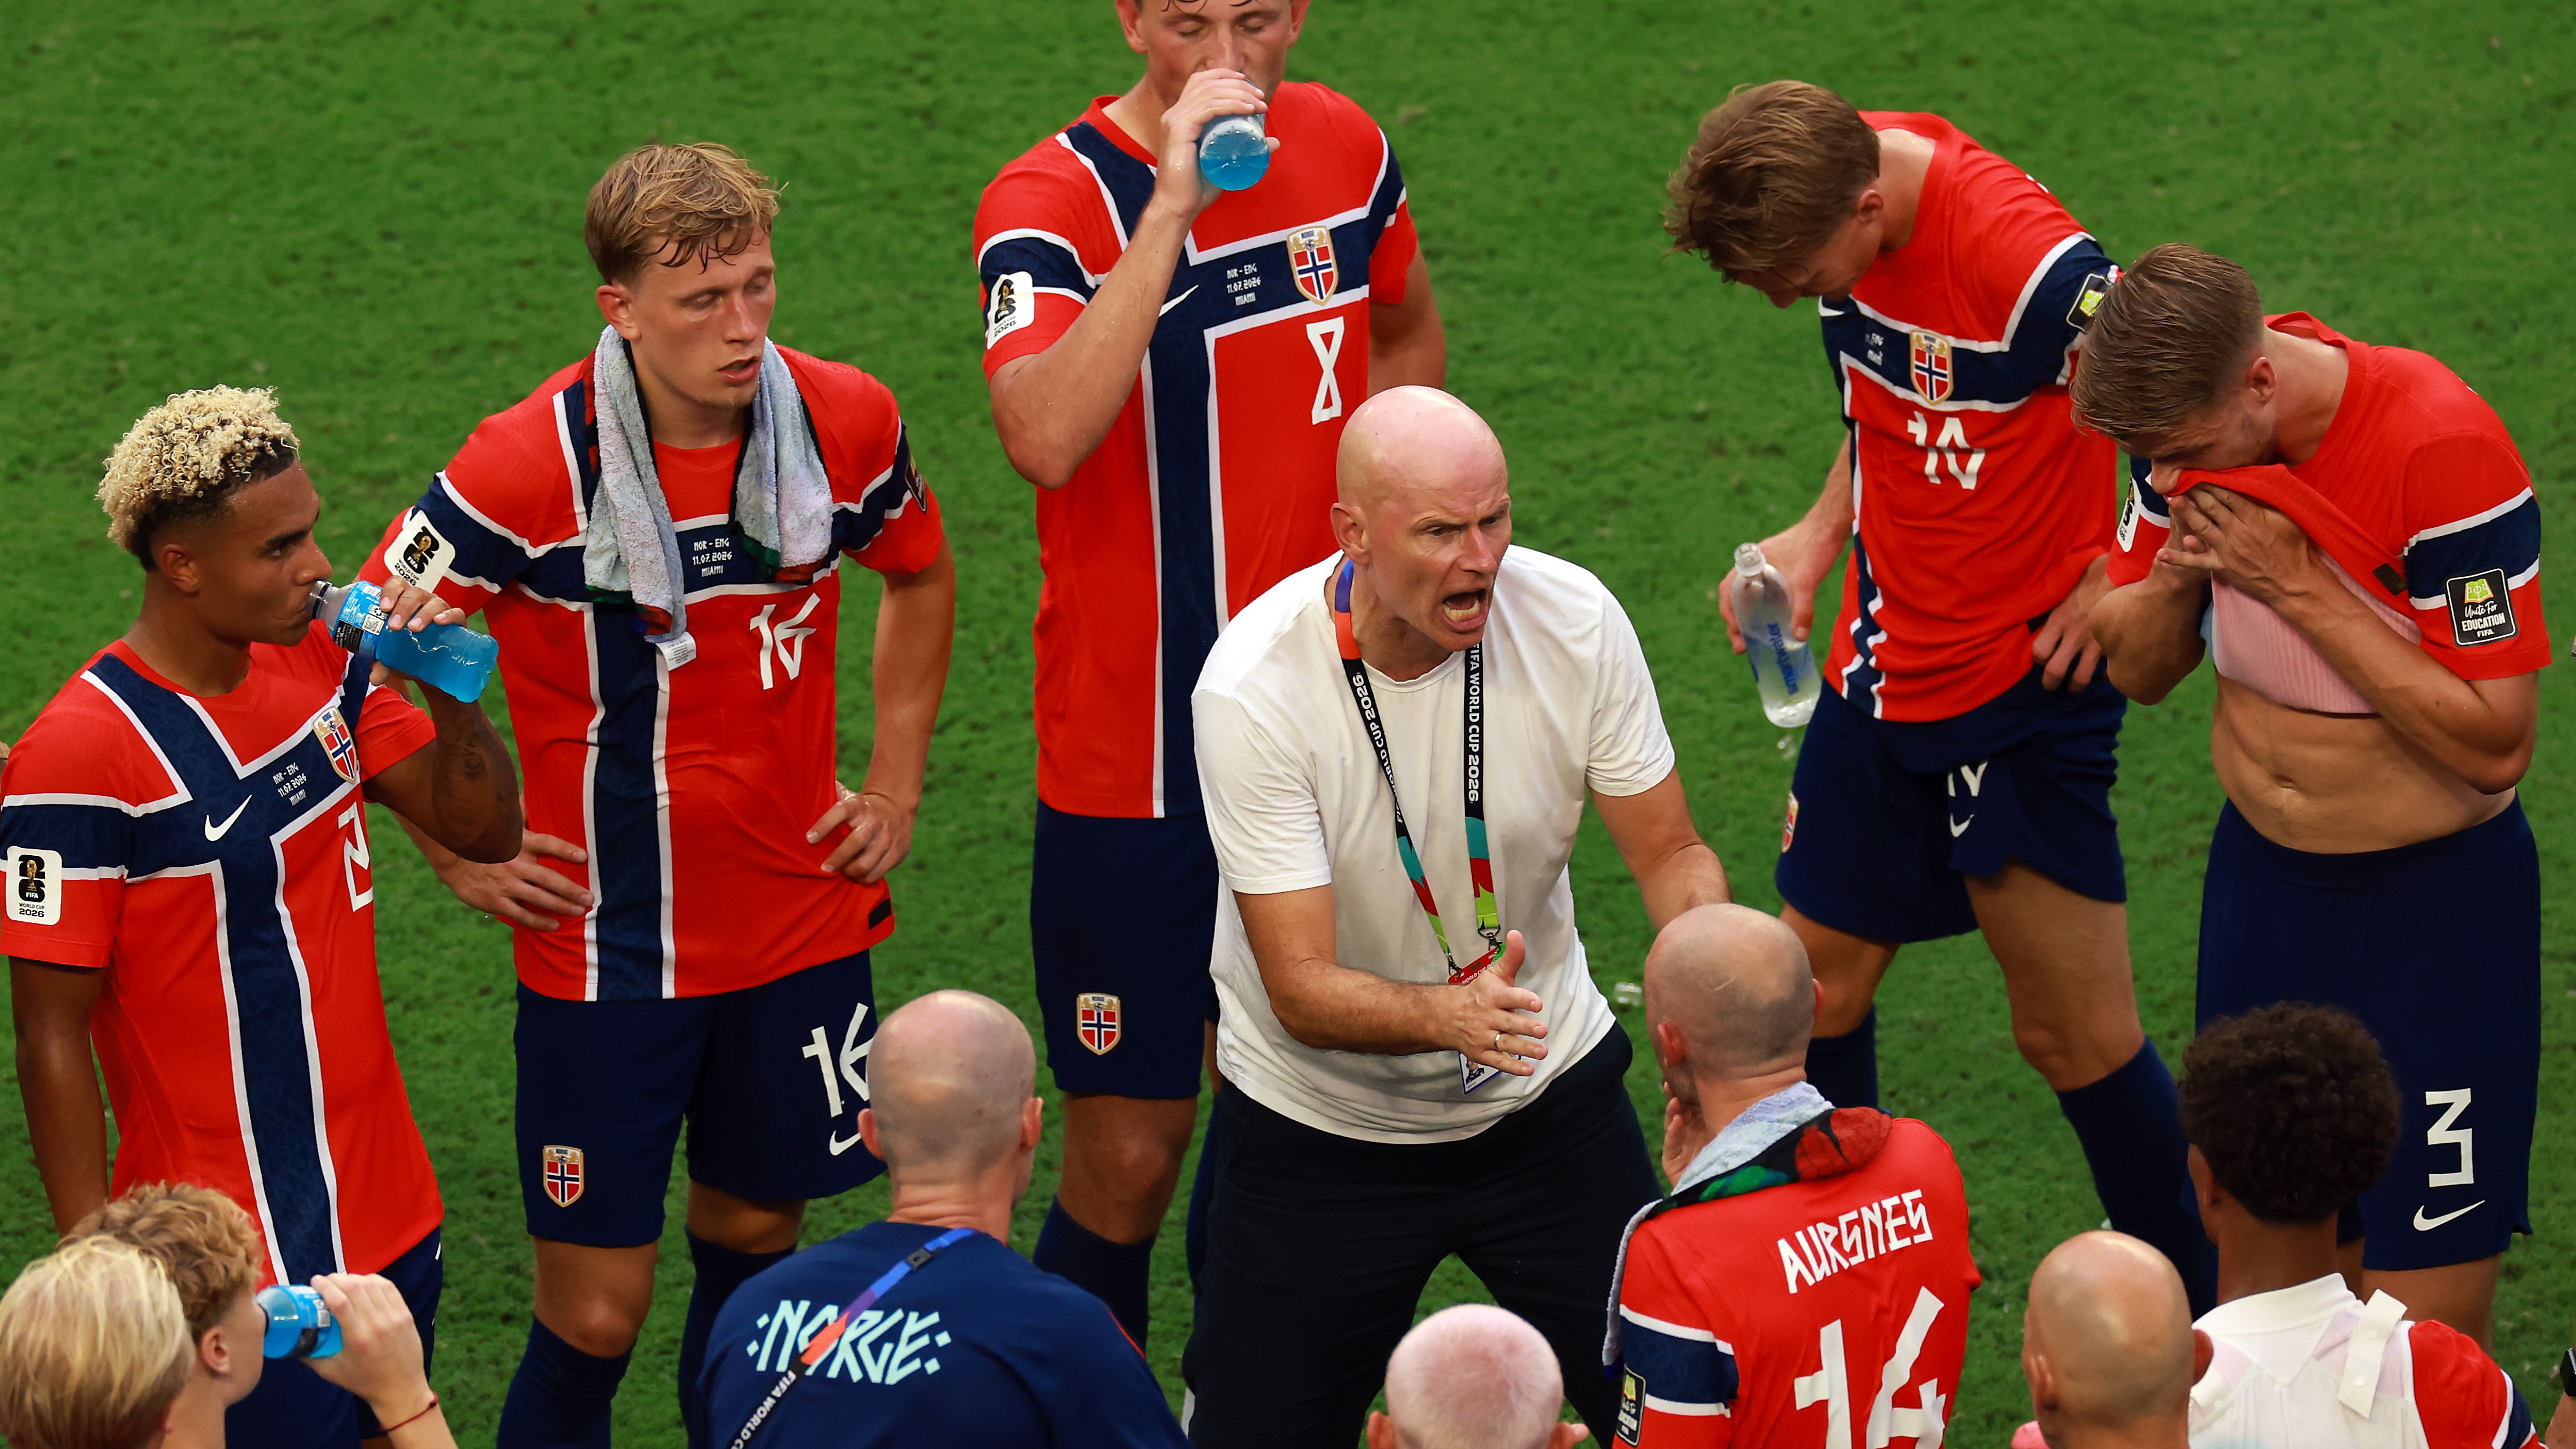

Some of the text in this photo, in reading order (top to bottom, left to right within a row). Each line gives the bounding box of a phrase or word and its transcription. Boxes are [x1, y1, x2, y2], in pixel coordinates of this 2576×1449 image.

[1227, 268, 1238, 279] NOR
[1244, 263, 1257, 275] ENG
[1227, 276, 1261, 293] 11.07.2026
[1235, 292, 1256, 306] MIAMI
[994, 321, 1016, 337] 2026
[1306, 317, 1344, 425] 8
[694, 541, 707, 551] NOR
[715, 537, 729, 547] ENG
[692, 551, 733, 565] 11.07.2026
[395, 563, 416, 586] 2026
[701, 565, 723, 577] MIAMI
[2465, 601, 2497, 618] Unite For
[2462, 612, 2506, 632] EDUCATION
[2476, 629, 2493, 637] FIFA
[750, 593, 821, 690] 16
[1352, 673, 1376, 721] 2026
[1470, 673, 1480, 722] WORLD
[1370, 722, 1384, 748] CUP
[1469, 725, 1480, 752] CUP
[273, 772, 284, 784] NOR
[286, 762, 299, 775] ENG
[1469, 755, 1479, 802] 2026
[277, 773, 307, 797] 11.07.2026
[289, 789, 306, 806] MIAMI
[19, 908, 45, 918] 2026
[2425, 1088, 2474, 1188] 3
[1777, 1189, 1934, 1294] AURSNES
[771, 1370, 797, 1397] FIFA
[741, 1396, 777, 1440] WORLD
